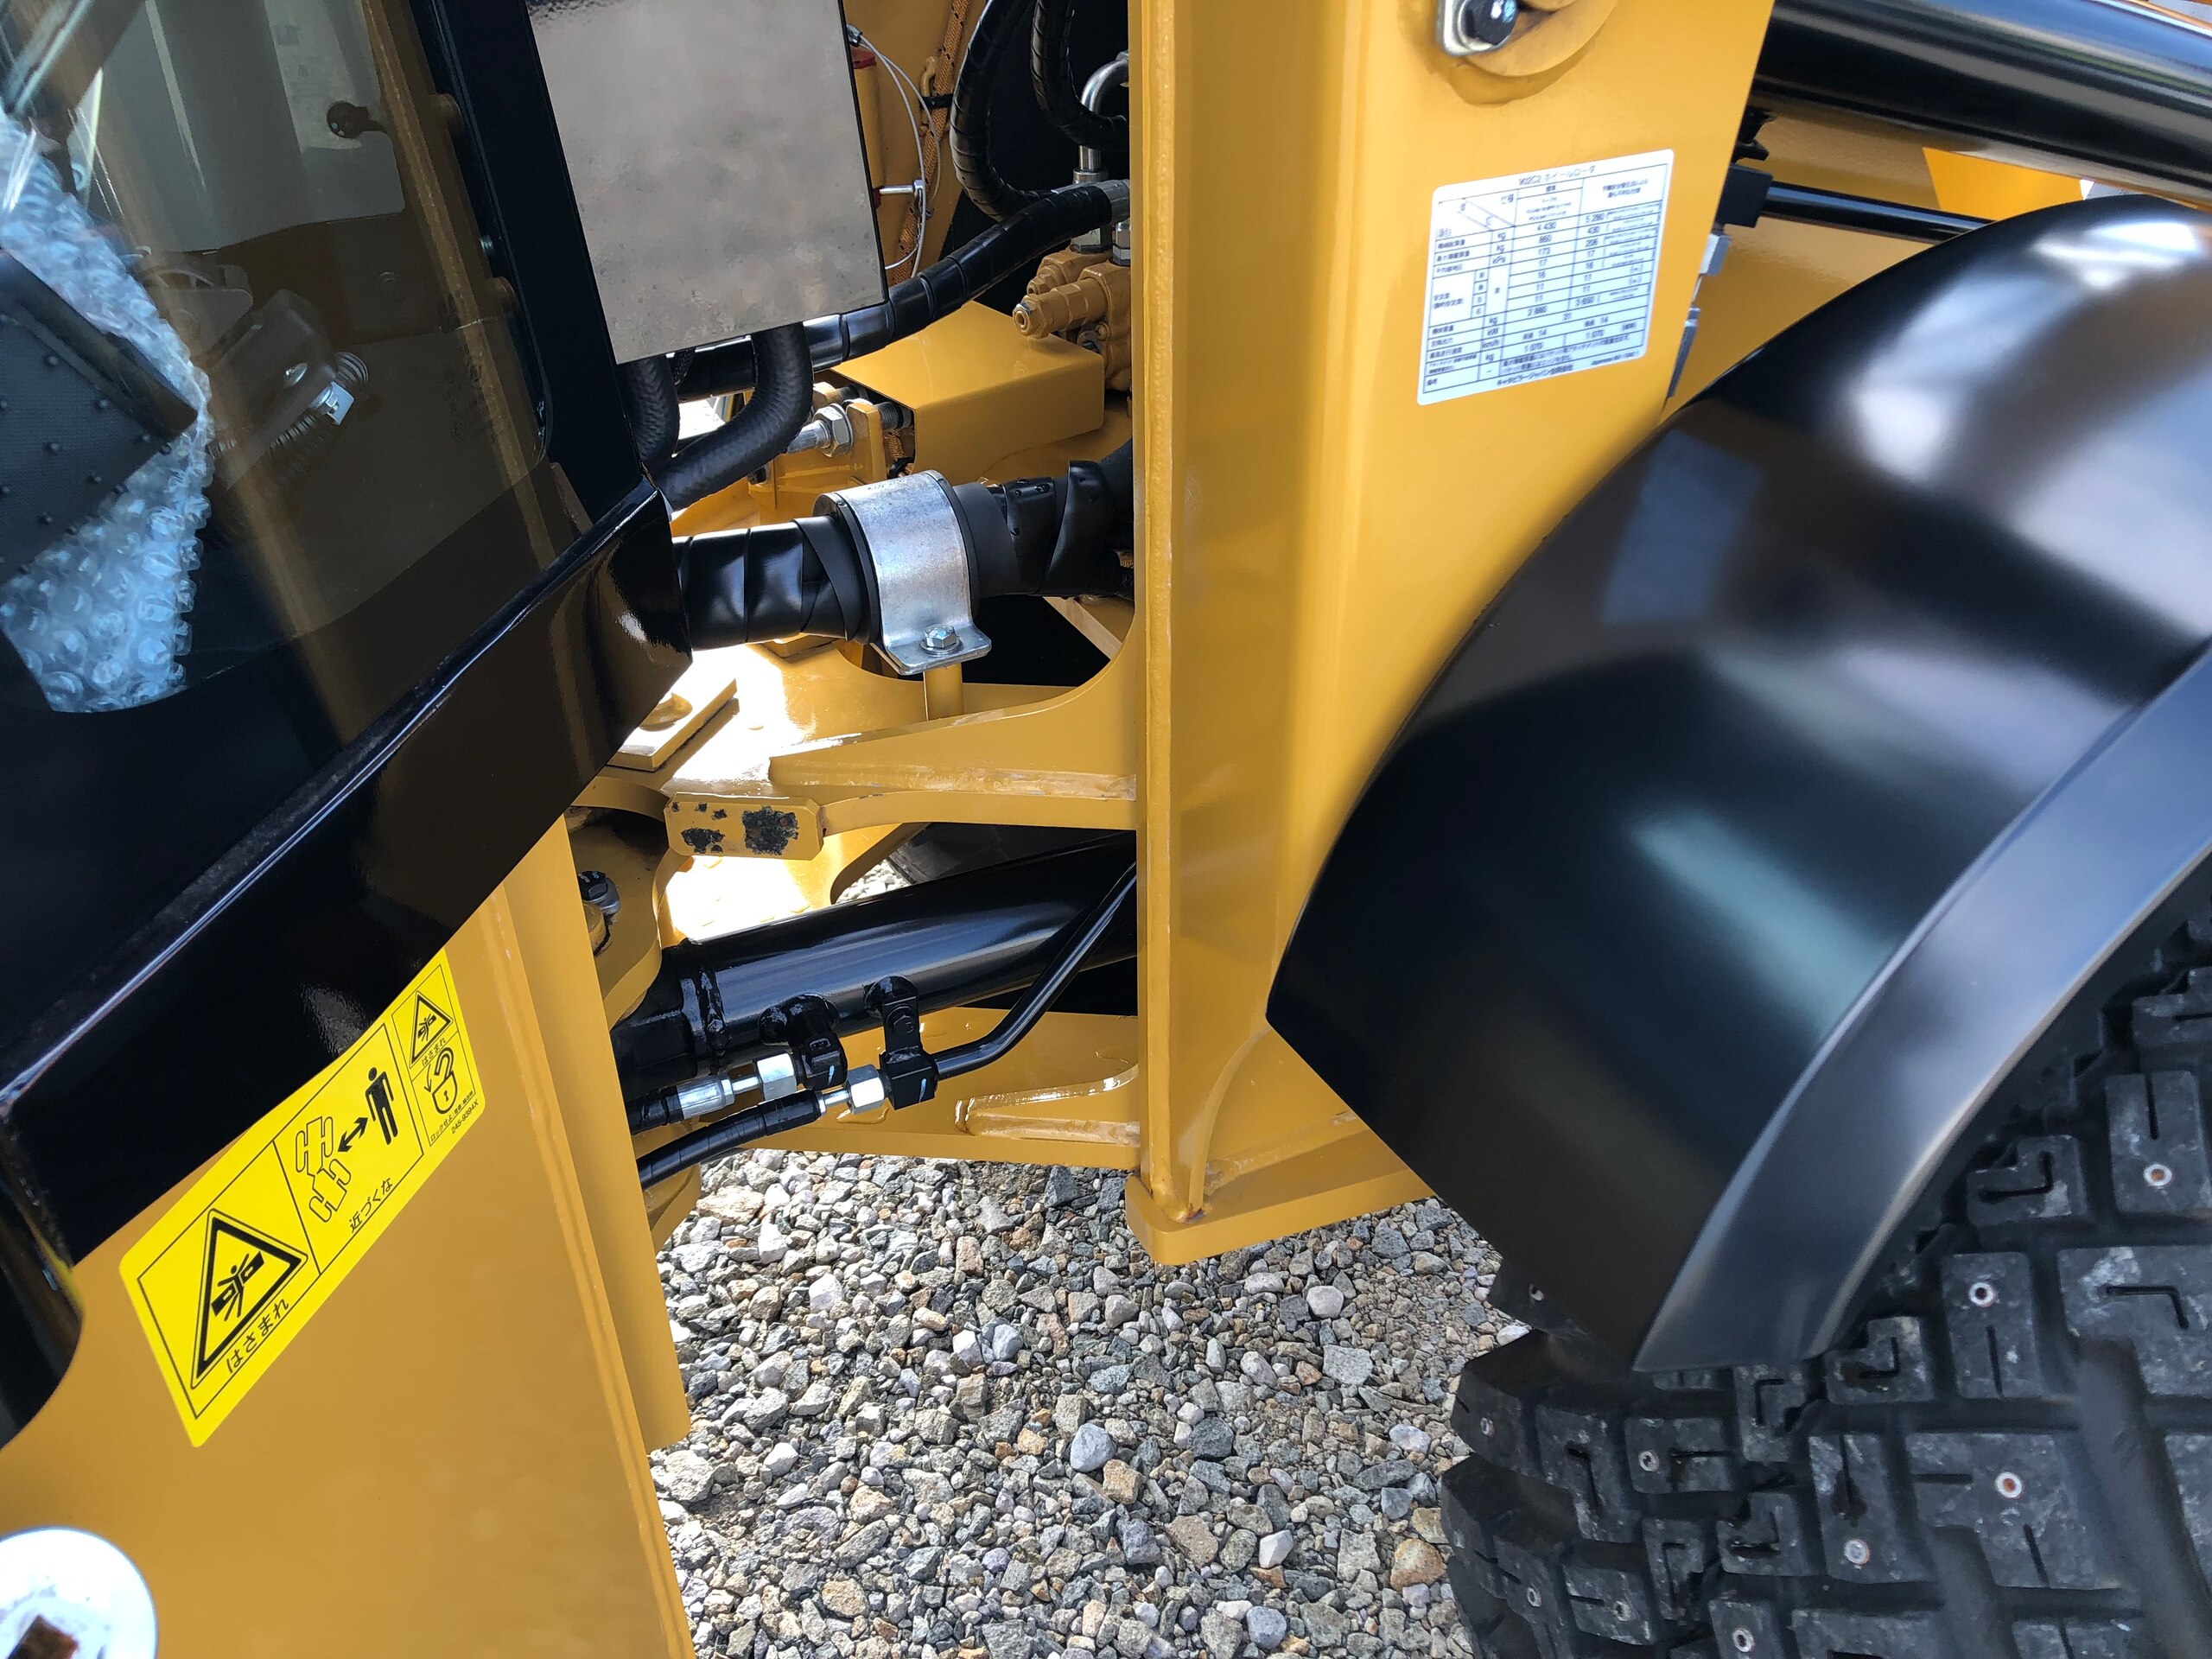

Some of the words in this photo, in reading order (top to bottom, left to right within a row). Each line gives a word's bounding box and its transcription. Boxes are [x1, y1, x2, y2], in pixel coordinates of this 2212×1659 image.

[422, 1038, 446, 1067] はさまれ
[451, 1100, 479, 1135] 245-9394X
[348, 1177, 393, 1233] 近づくな
[226, 1299, 289, 1374] はさまれ
